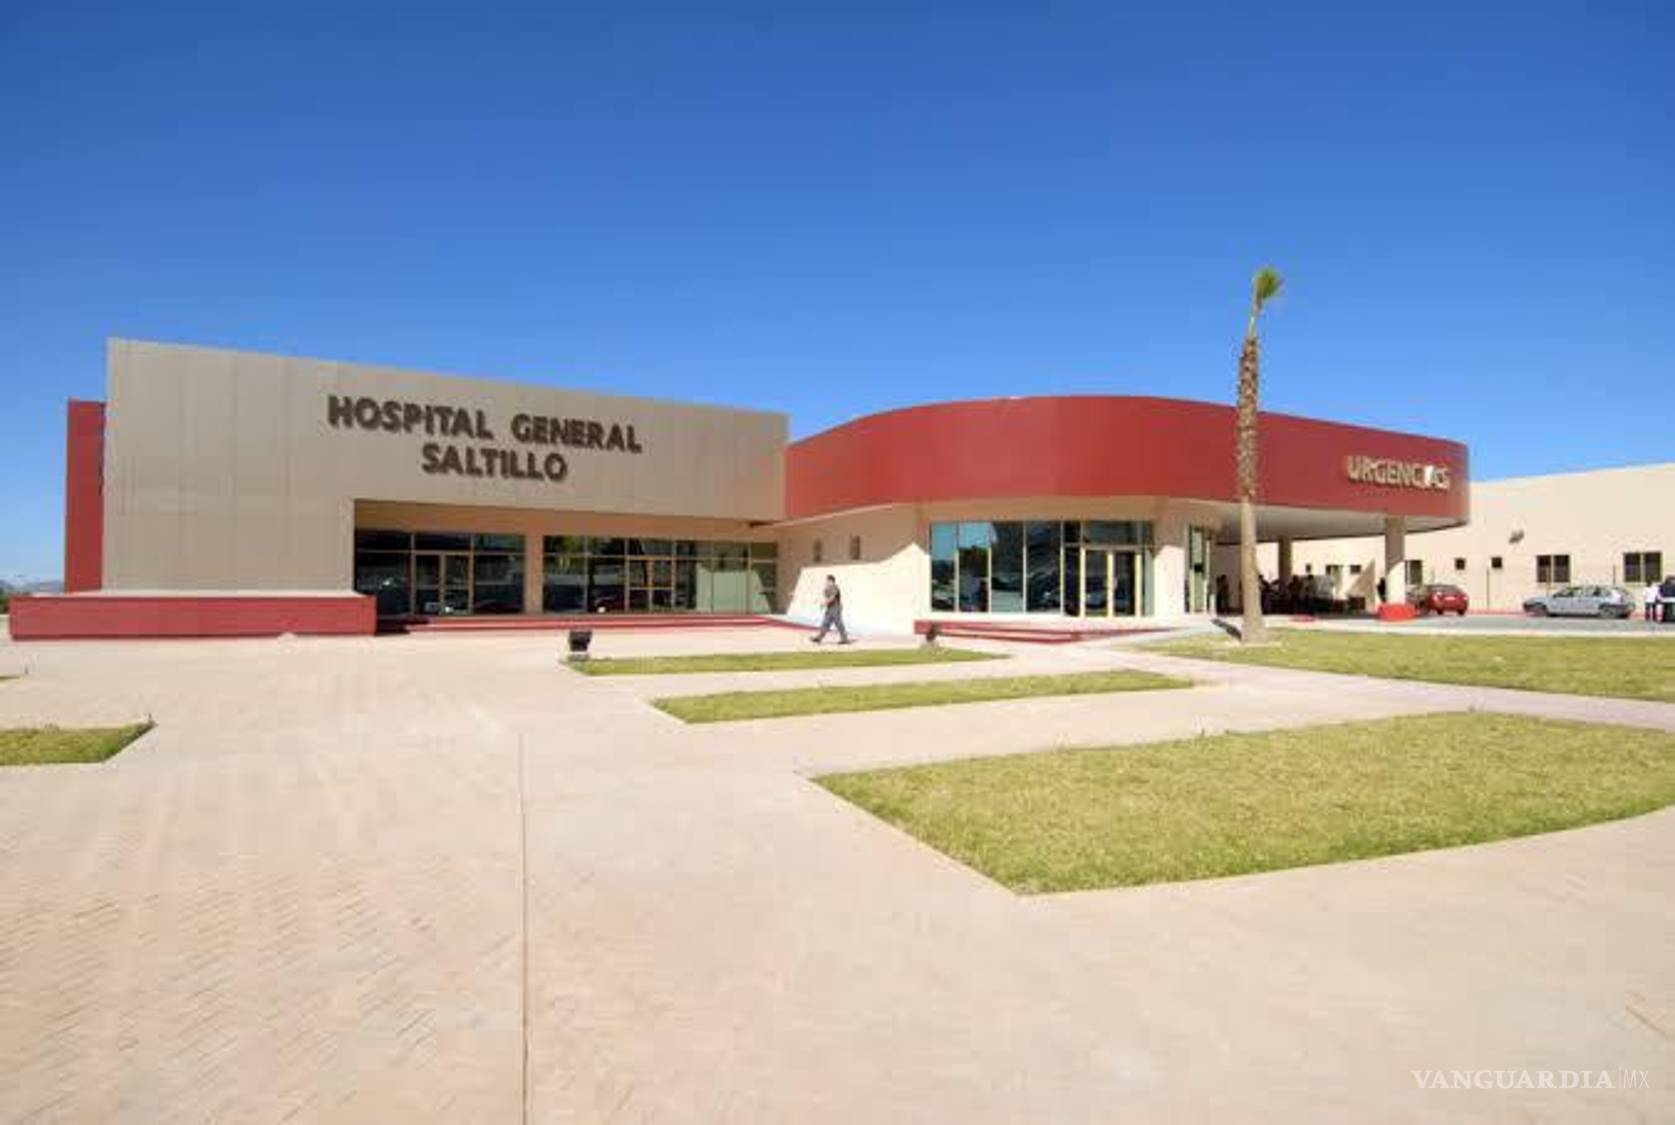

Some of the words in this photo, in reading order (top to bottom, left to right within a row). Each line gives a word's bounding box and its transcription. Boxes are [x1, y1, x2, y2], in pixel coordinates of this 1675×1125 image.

[327, 395, 494, 440] HOSPITAL
[511, 413, 643, 453] GENERAL
[421, 443, 569, 482] SALTILLO
